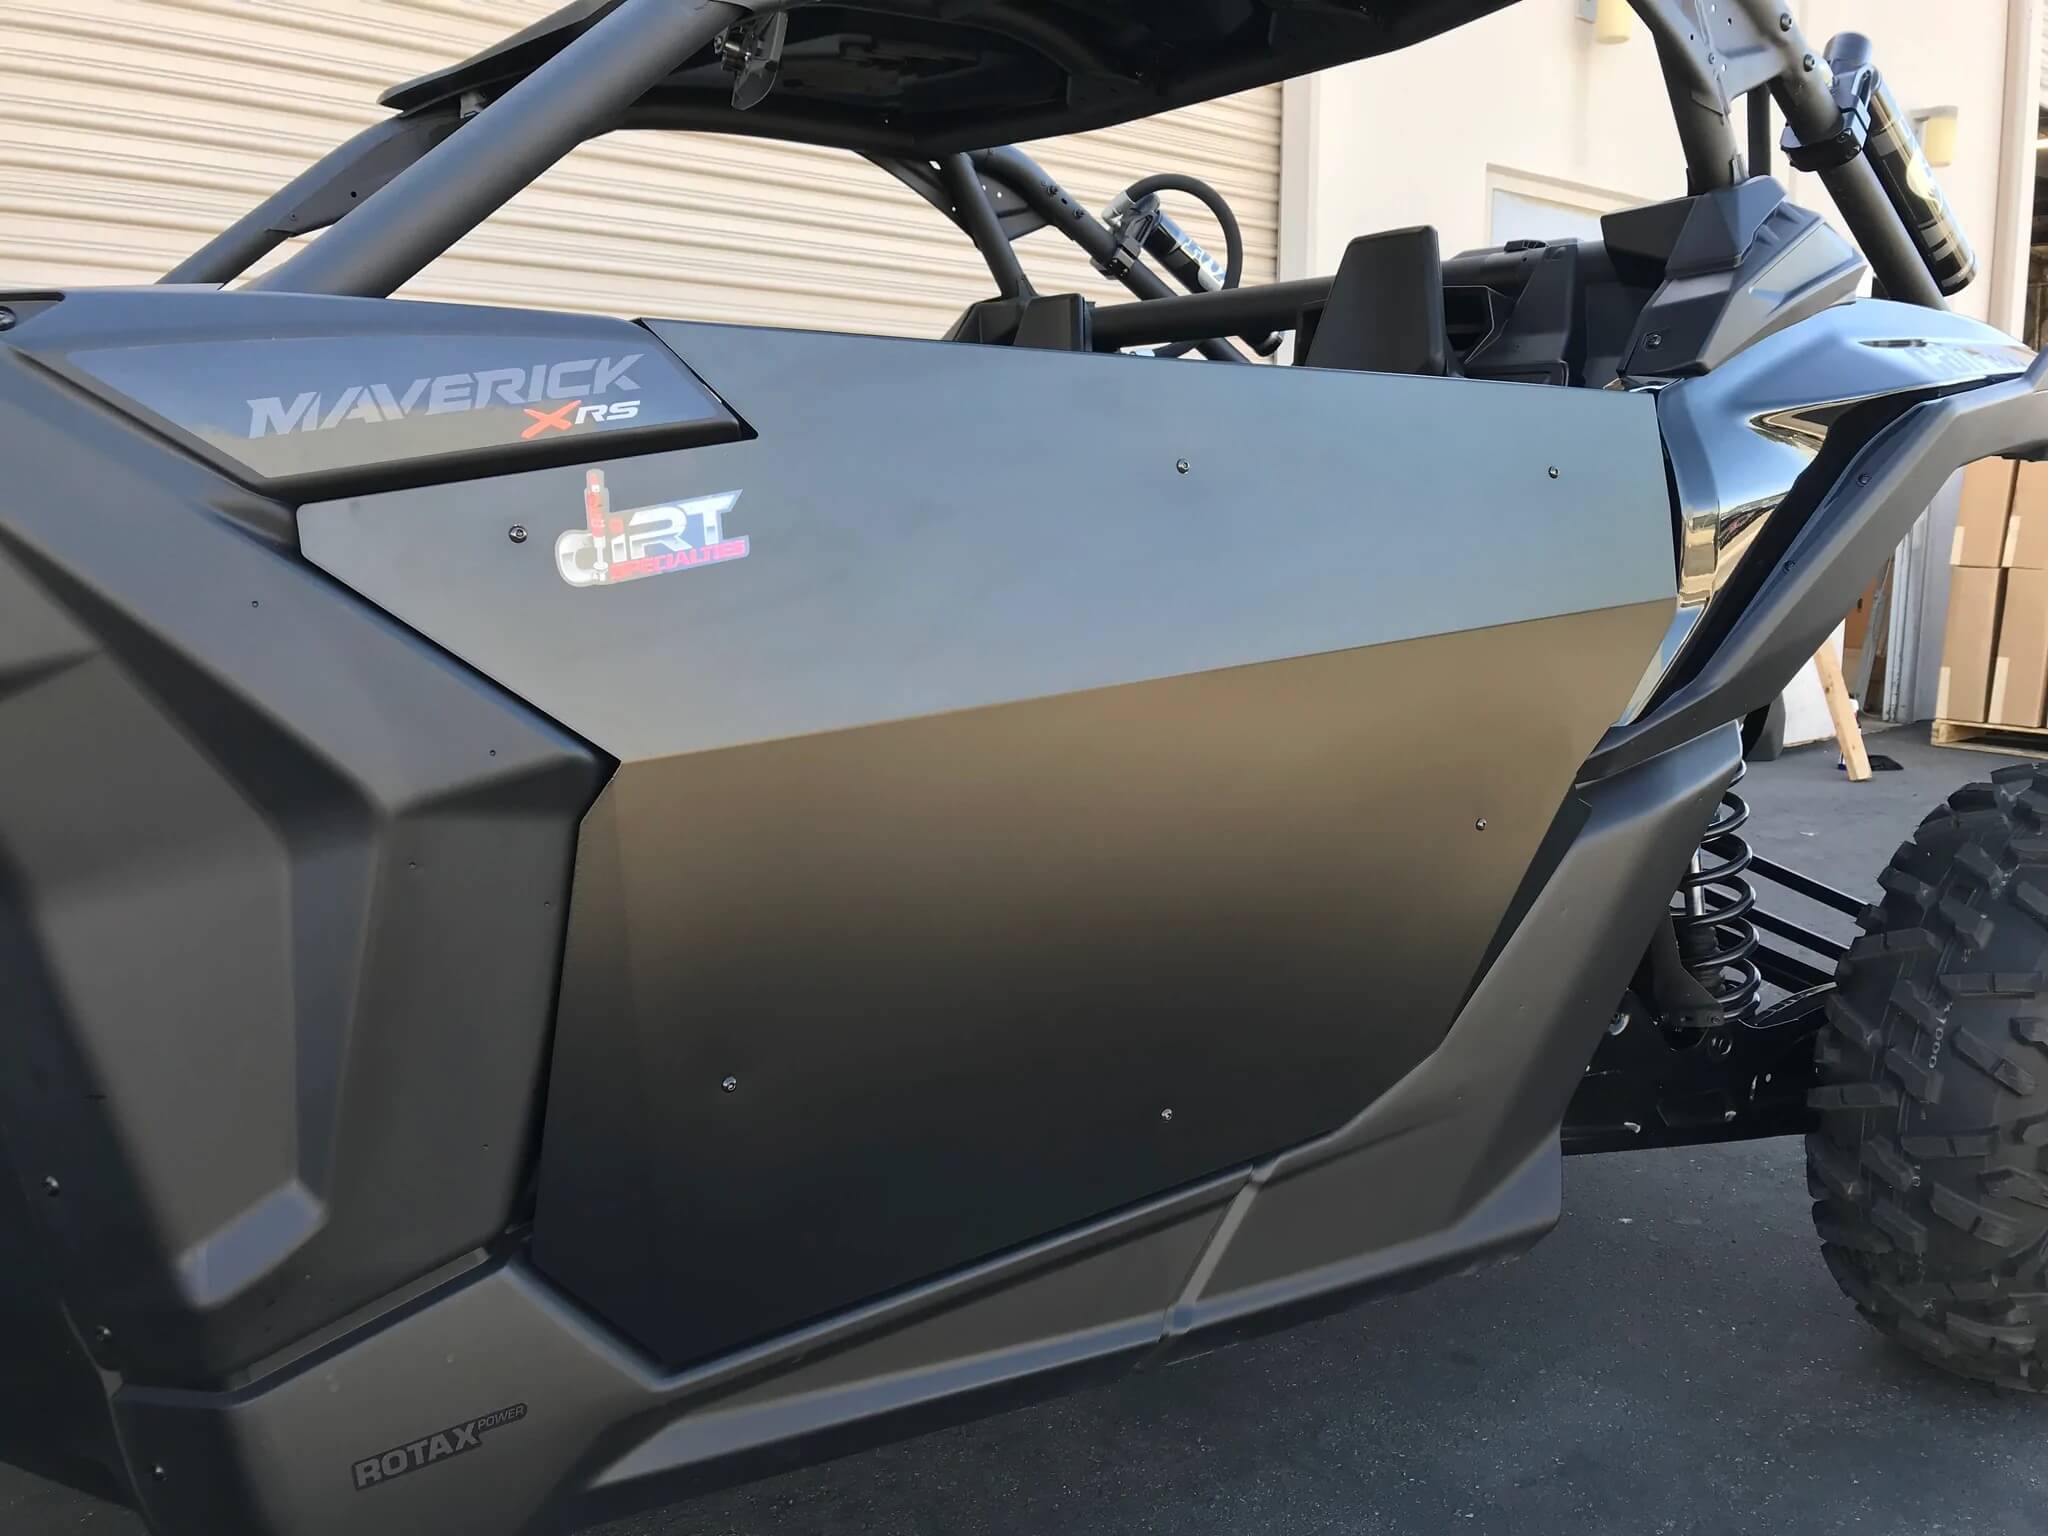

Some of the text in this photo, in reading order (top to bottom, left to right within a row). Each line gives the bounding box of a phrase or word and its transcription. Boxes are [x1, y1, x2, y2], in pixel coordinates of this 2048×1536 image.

[247, 353, 645, 439] MAVERICK
[354, 1405, 525, 1487] ROTAX POWER
